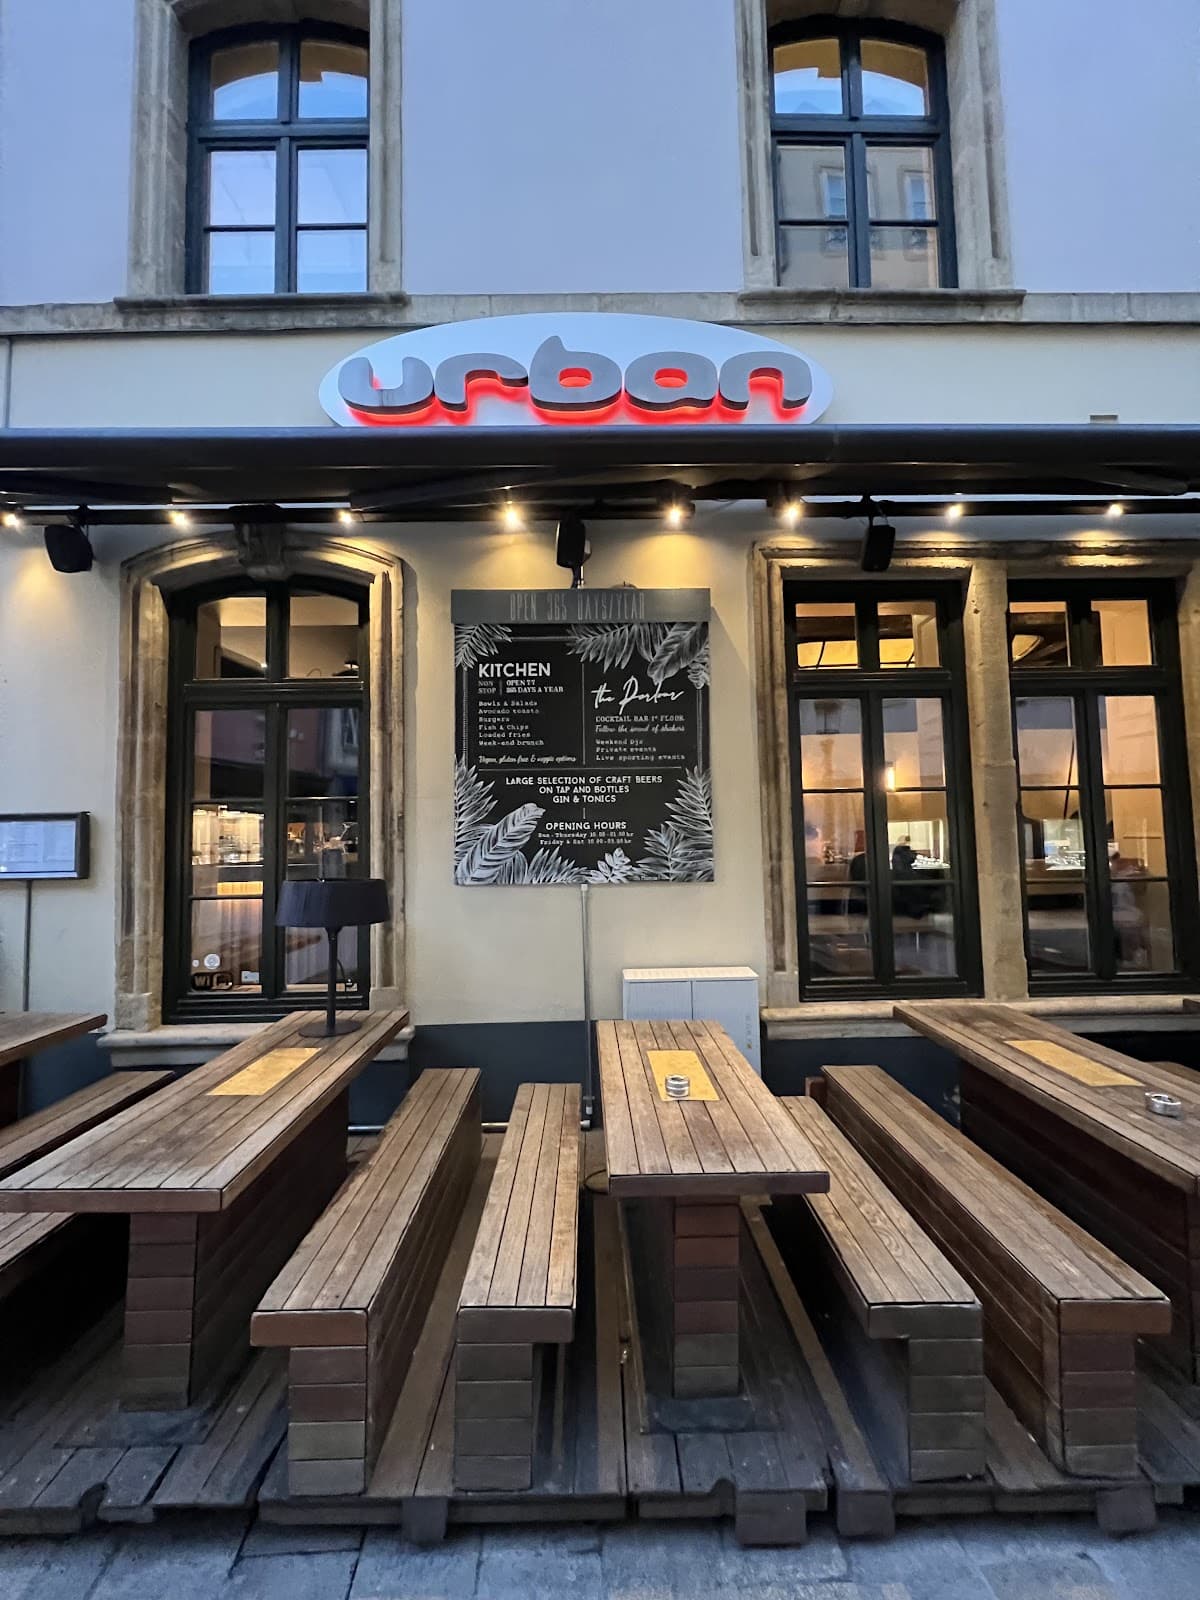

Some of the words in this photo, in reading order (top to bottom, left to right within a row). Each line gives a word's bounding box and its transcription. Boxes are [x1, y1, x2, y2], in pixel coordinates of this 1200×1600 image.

[338, 335, 813, 412] urban
[510, 592, 537, 621] OPEN
[547, 592, 567, 620] 365
[577, 590, 646, 620] DAYS/YEAR
[479, 662, 551, 678] KITCHEN
[506, 679, 526, 687] OPEN
[591, 682, 616, 709] the
[506, 724, 529, 732] Chips
[505, 777, 534, 785] LARGE
[537, 776, 586, 785] SELECTION
[588, 776, 602, 784] OF
[605, 776, 632, 784] CRAFT
[635, 775, 663, 784] BEERS
[539, 786, 553, 794] ON
[555, 786, 569, 794] TAP
[572, 786, 592, 794] AND
[594, 785, 630, 793] BOTTLES
[552, 795, 570, 803] GIN
[573, 795, 580, 803] &
[582, 795, 617, 803] TONICS
[545, 822, 591, 831] OPENING
[593, 821, 627, 830] HOURS
